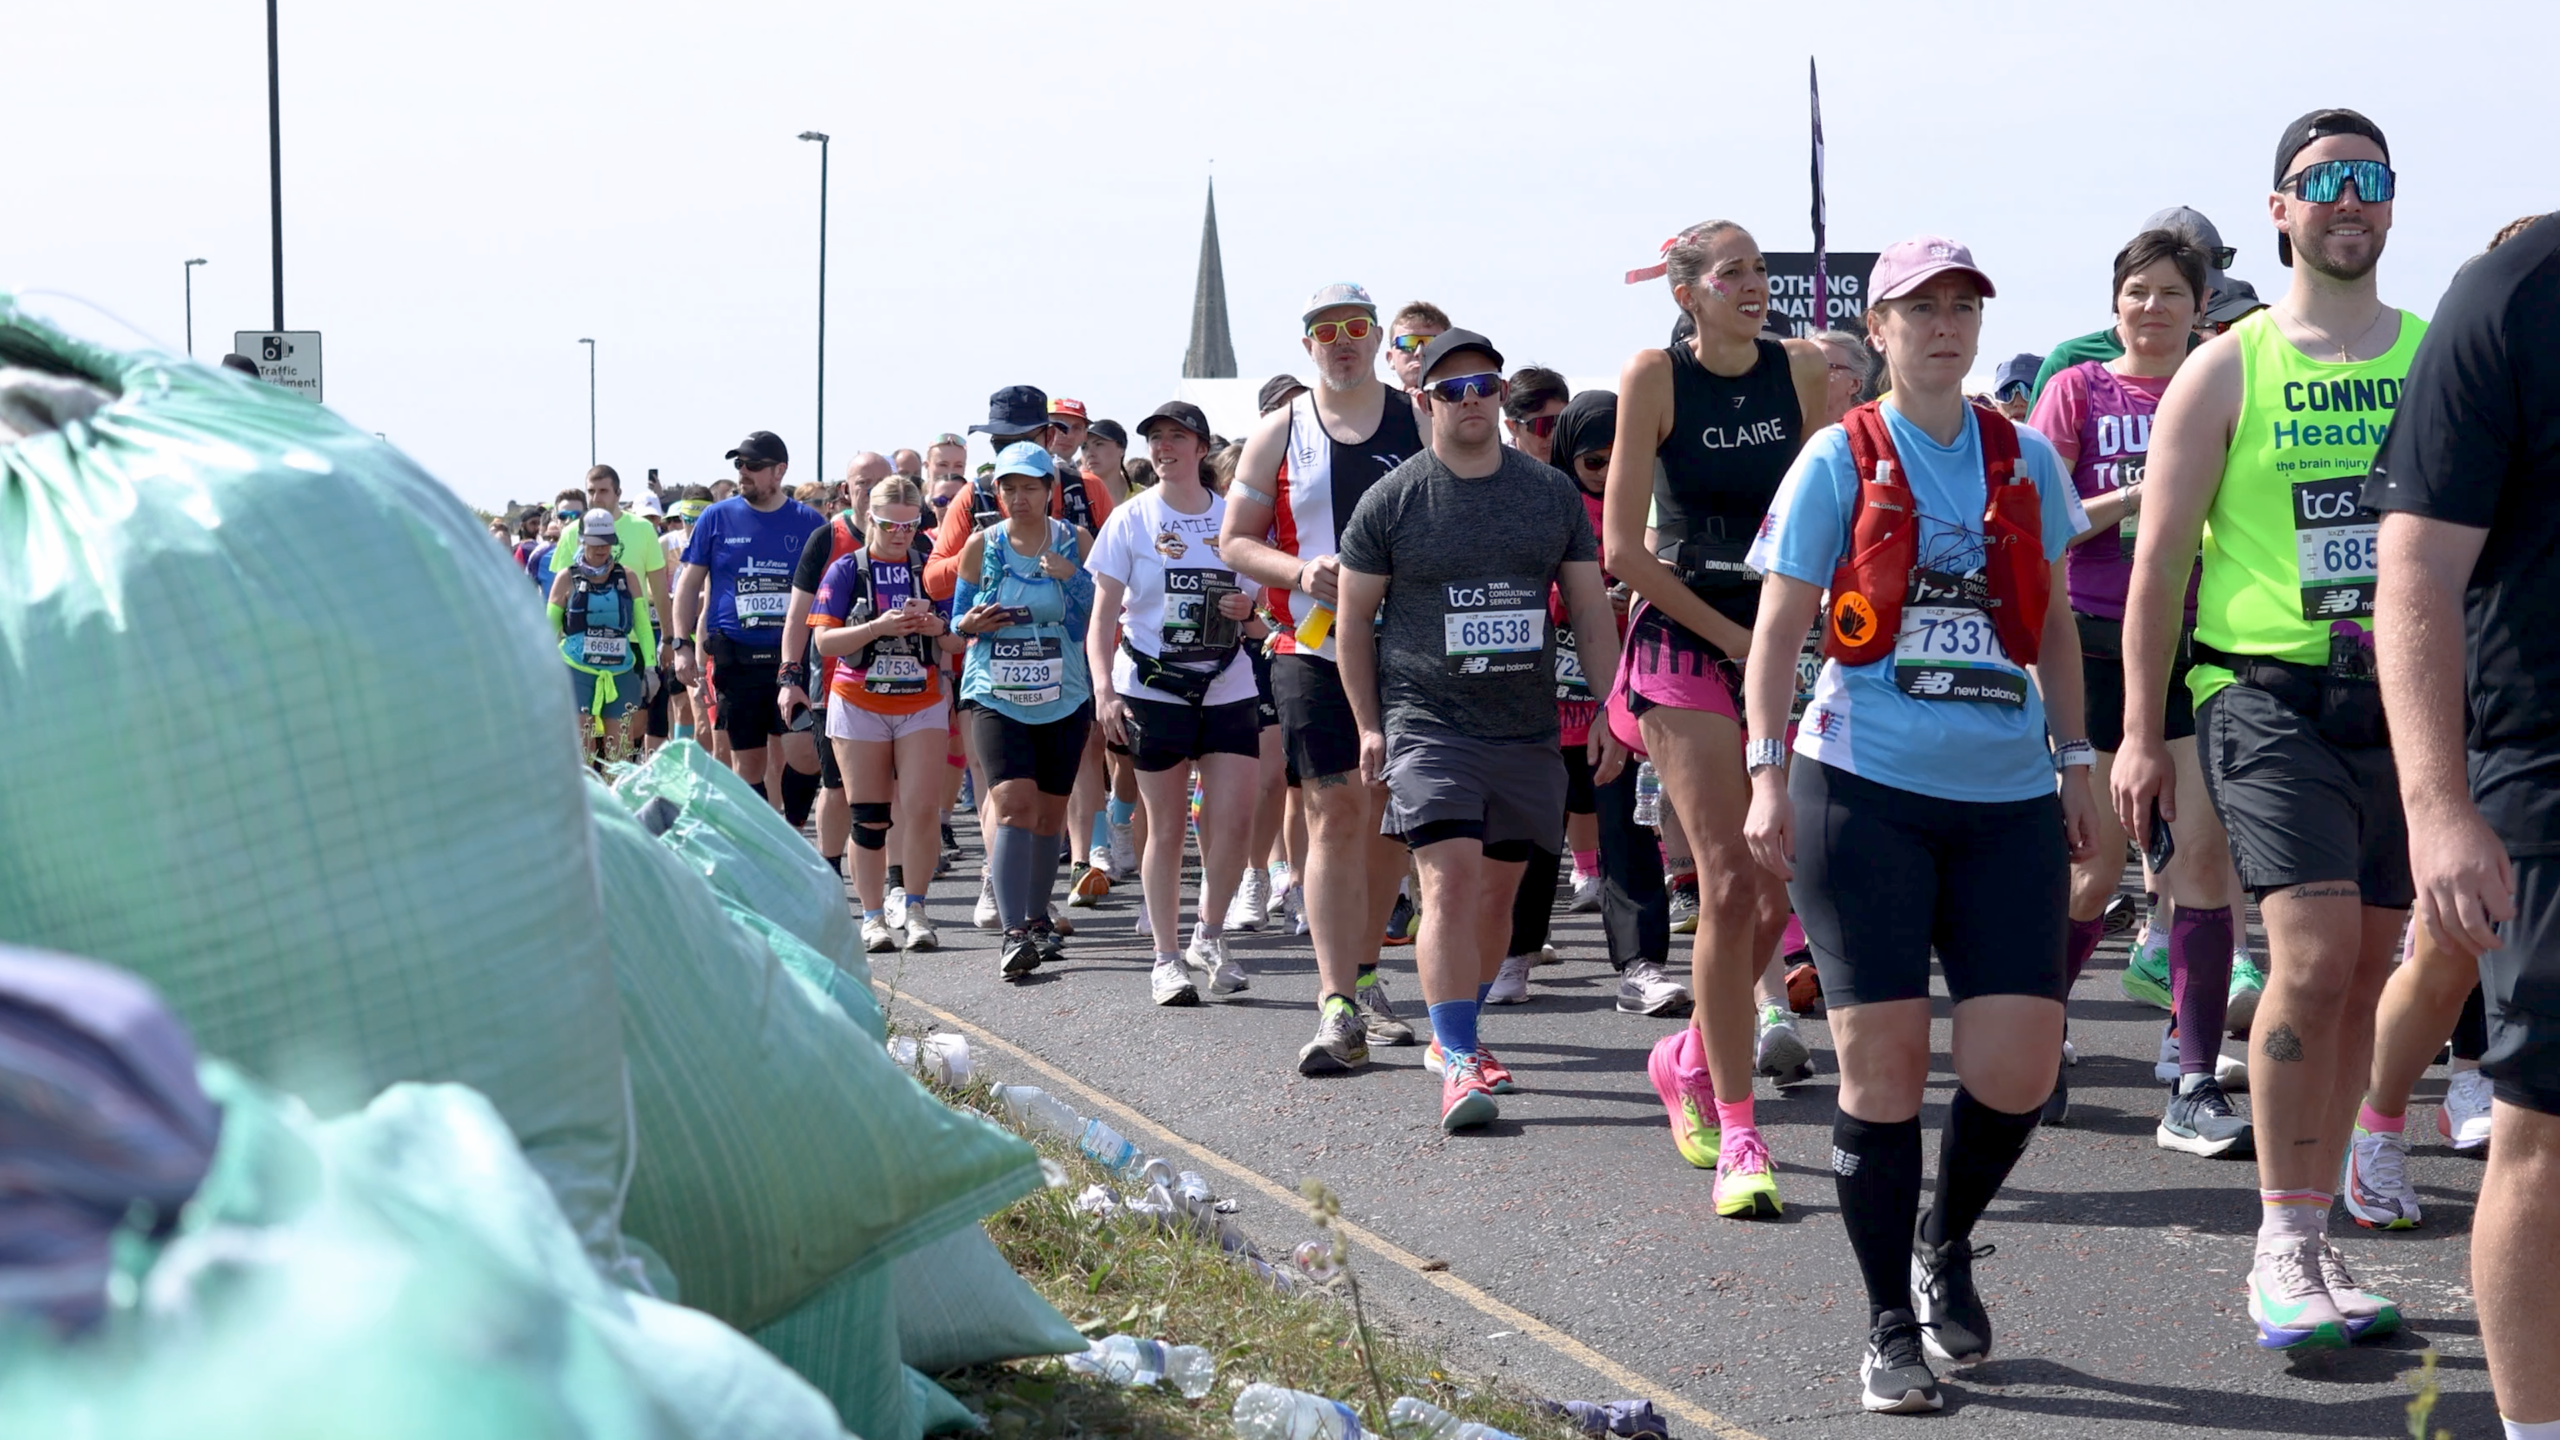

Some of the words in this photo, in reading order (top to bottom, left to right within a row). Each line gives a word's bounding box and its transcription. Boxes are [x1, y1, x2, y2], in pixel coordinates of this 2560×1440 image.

[259, 365, 298, 376] Traffic
[1702, 417, 1786, 449] CLAIRE
[2098, 414, 2155, 457] DU
[2276, 461, 2296, 472] the
[2299, 458, 2331, 470] brain
[2335, 458, 2368, 470] injury
[1869, 500, 1904, 513] SALOMON
[2302, 489, 2356, 520] tcs
[1160, 517, 1219, 534] KATIE
[723, 537, 752, 545] ANDREW
[1705, 559, 1732, 571] LONDON
[875, 566, 911, 585] LISA
[1170, 572, 1199, 590] tcs
[737, 580, 758, 593] tcs
[1488, 582, 1510, 590] TATA
[1449, 586, 1486, 607] tcs
[1488, 590, 1537, 599] CONSULTANCY
[743, 598, 784, 612] 70824
[1489, 598, 1522, 607] SERVICES
[1462, 618, 1530, 646] 68538
[590, 640, 622, 652] 66984
[994, 642, 1020, 657] tcs
[1002, 665, 1050, 683] 73239
[1489, 665, 1506, 673] new
[1506, 662, 1534, 672] balance
[1009, 692, 1043, 704] THERESA
[1954, 685, 1979, 697] new
[1981, 688, 2021, 704] balance
